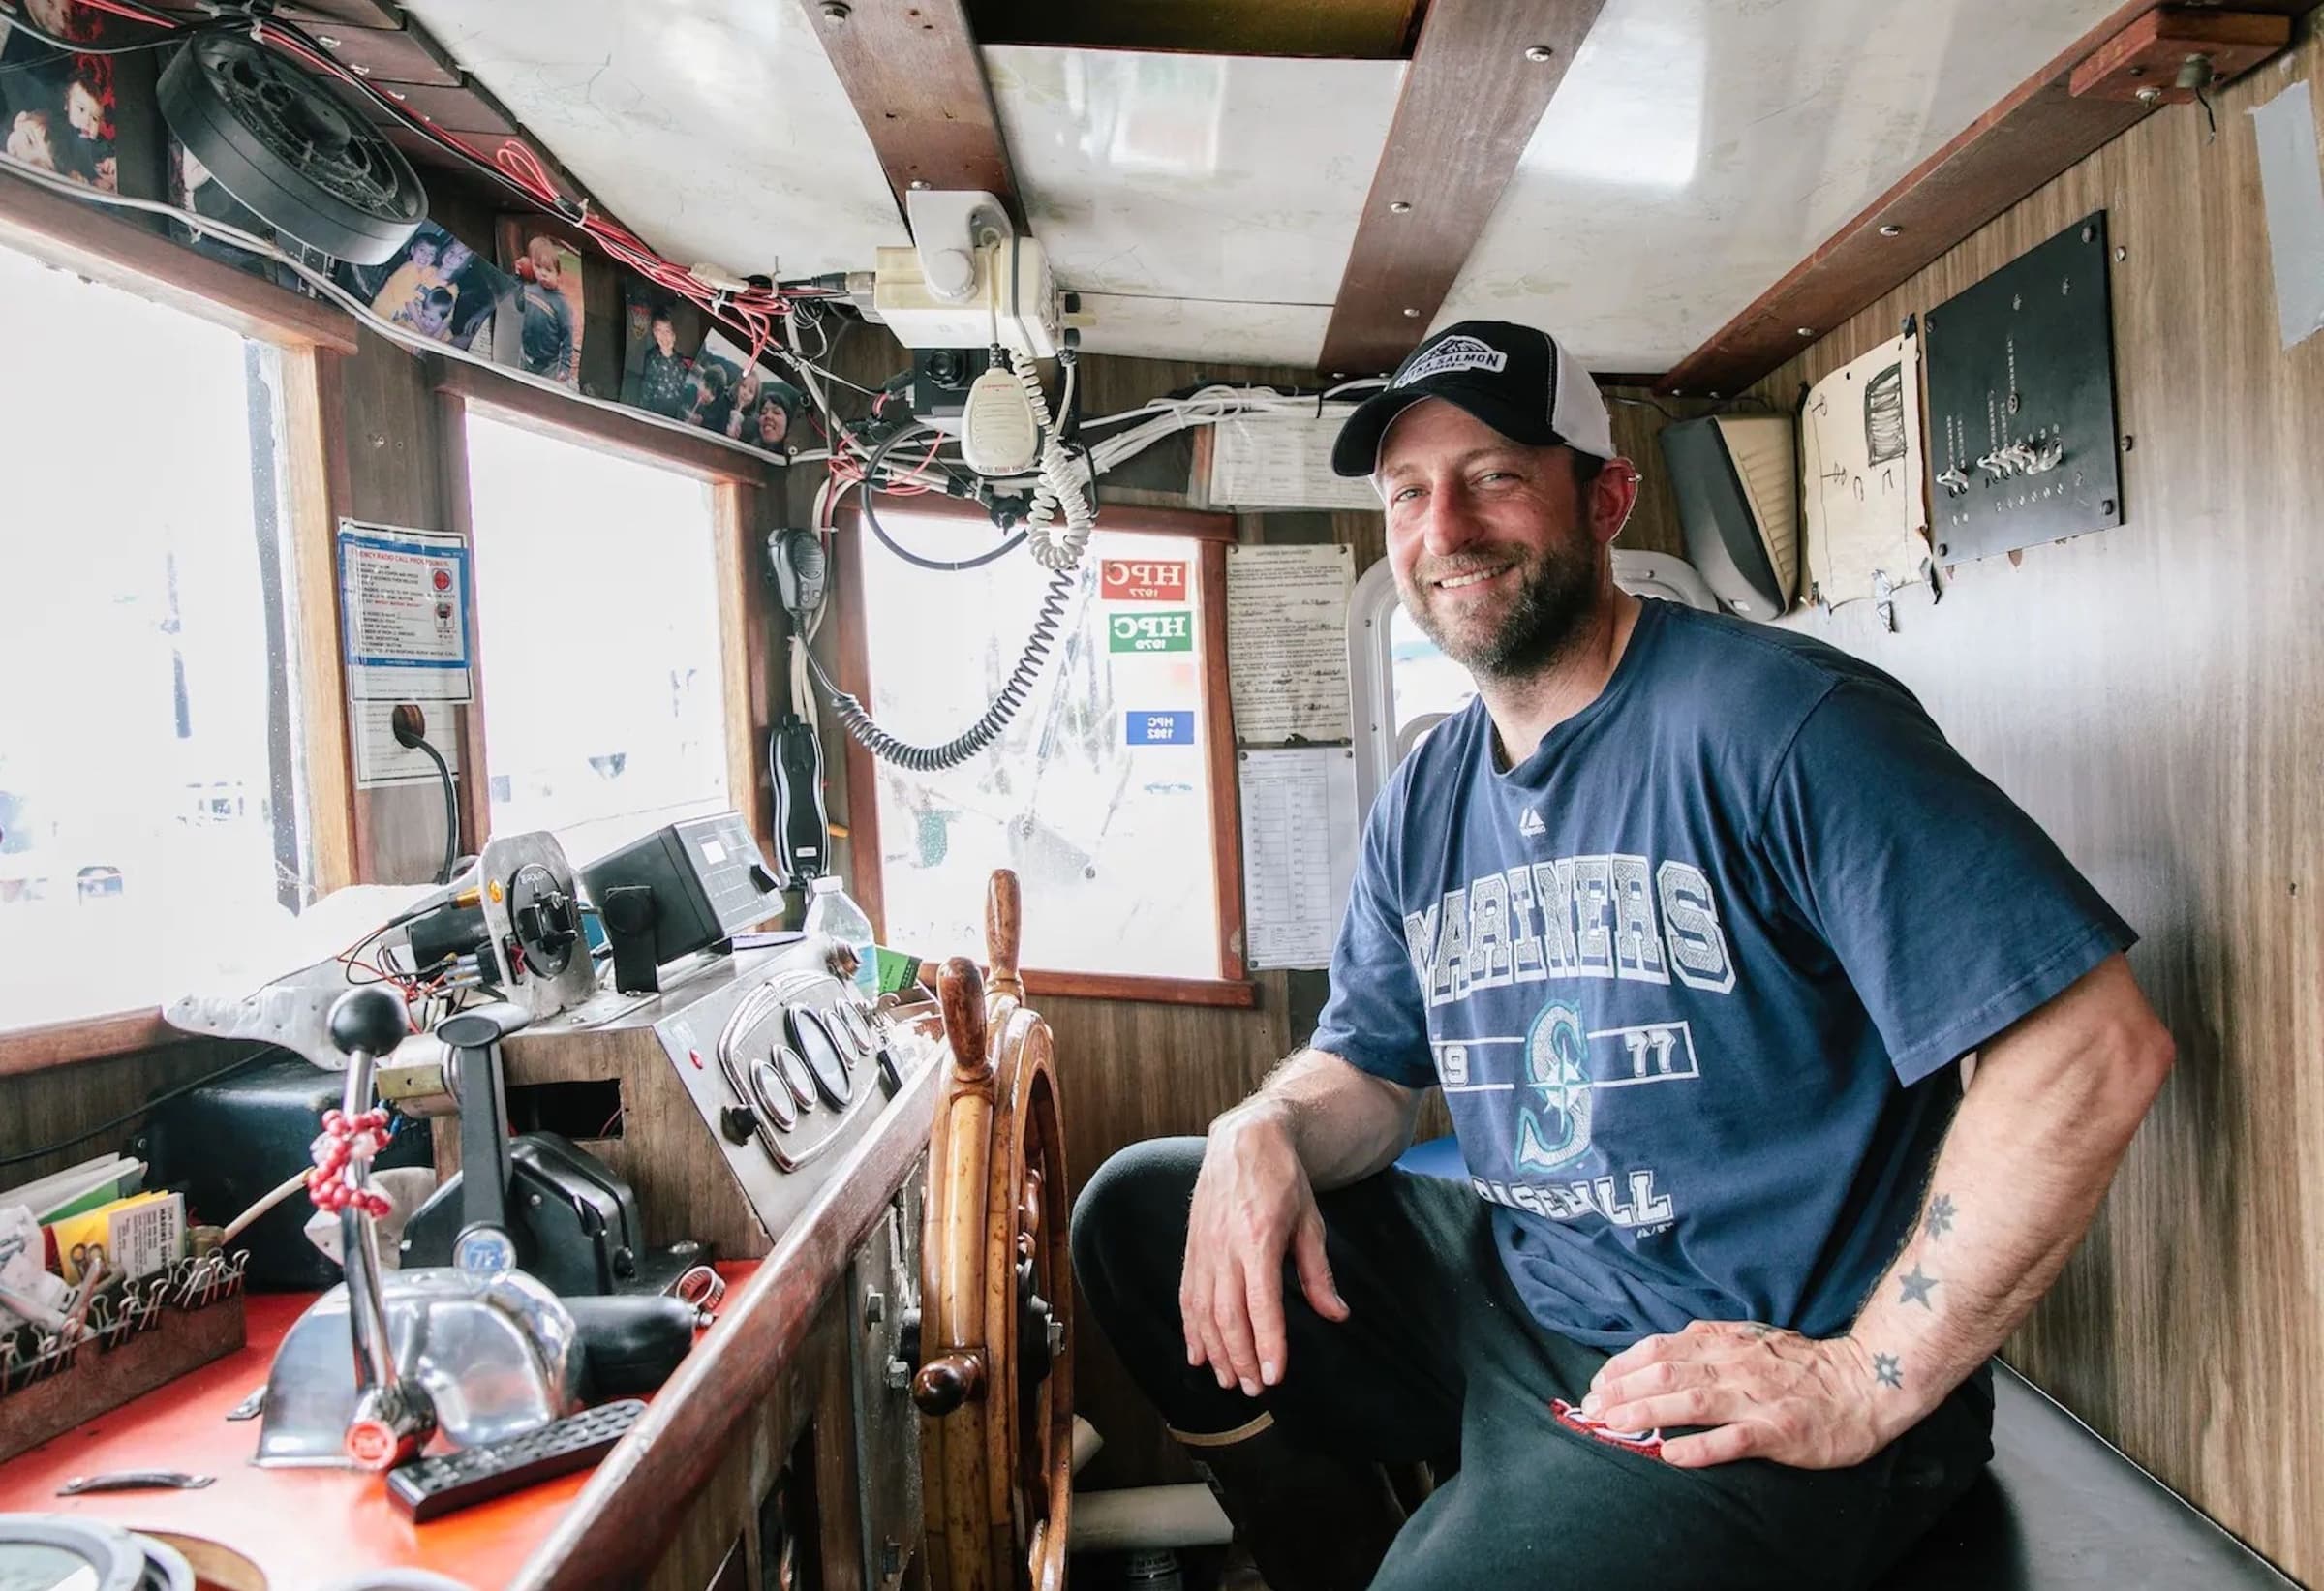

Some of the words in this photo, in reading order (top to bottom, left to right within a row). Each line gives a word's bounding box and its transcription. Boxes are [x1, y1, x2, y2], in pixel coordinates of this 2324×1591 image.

[1438, 352, 1500, 368] SALMON
[395, 555, 410, 565] CALL
[1404, 853, 1736, 1008] MARINERS
[1434, 1045, 1469, 1086] 19
[1624, 1028, 1677, 1078] 77
